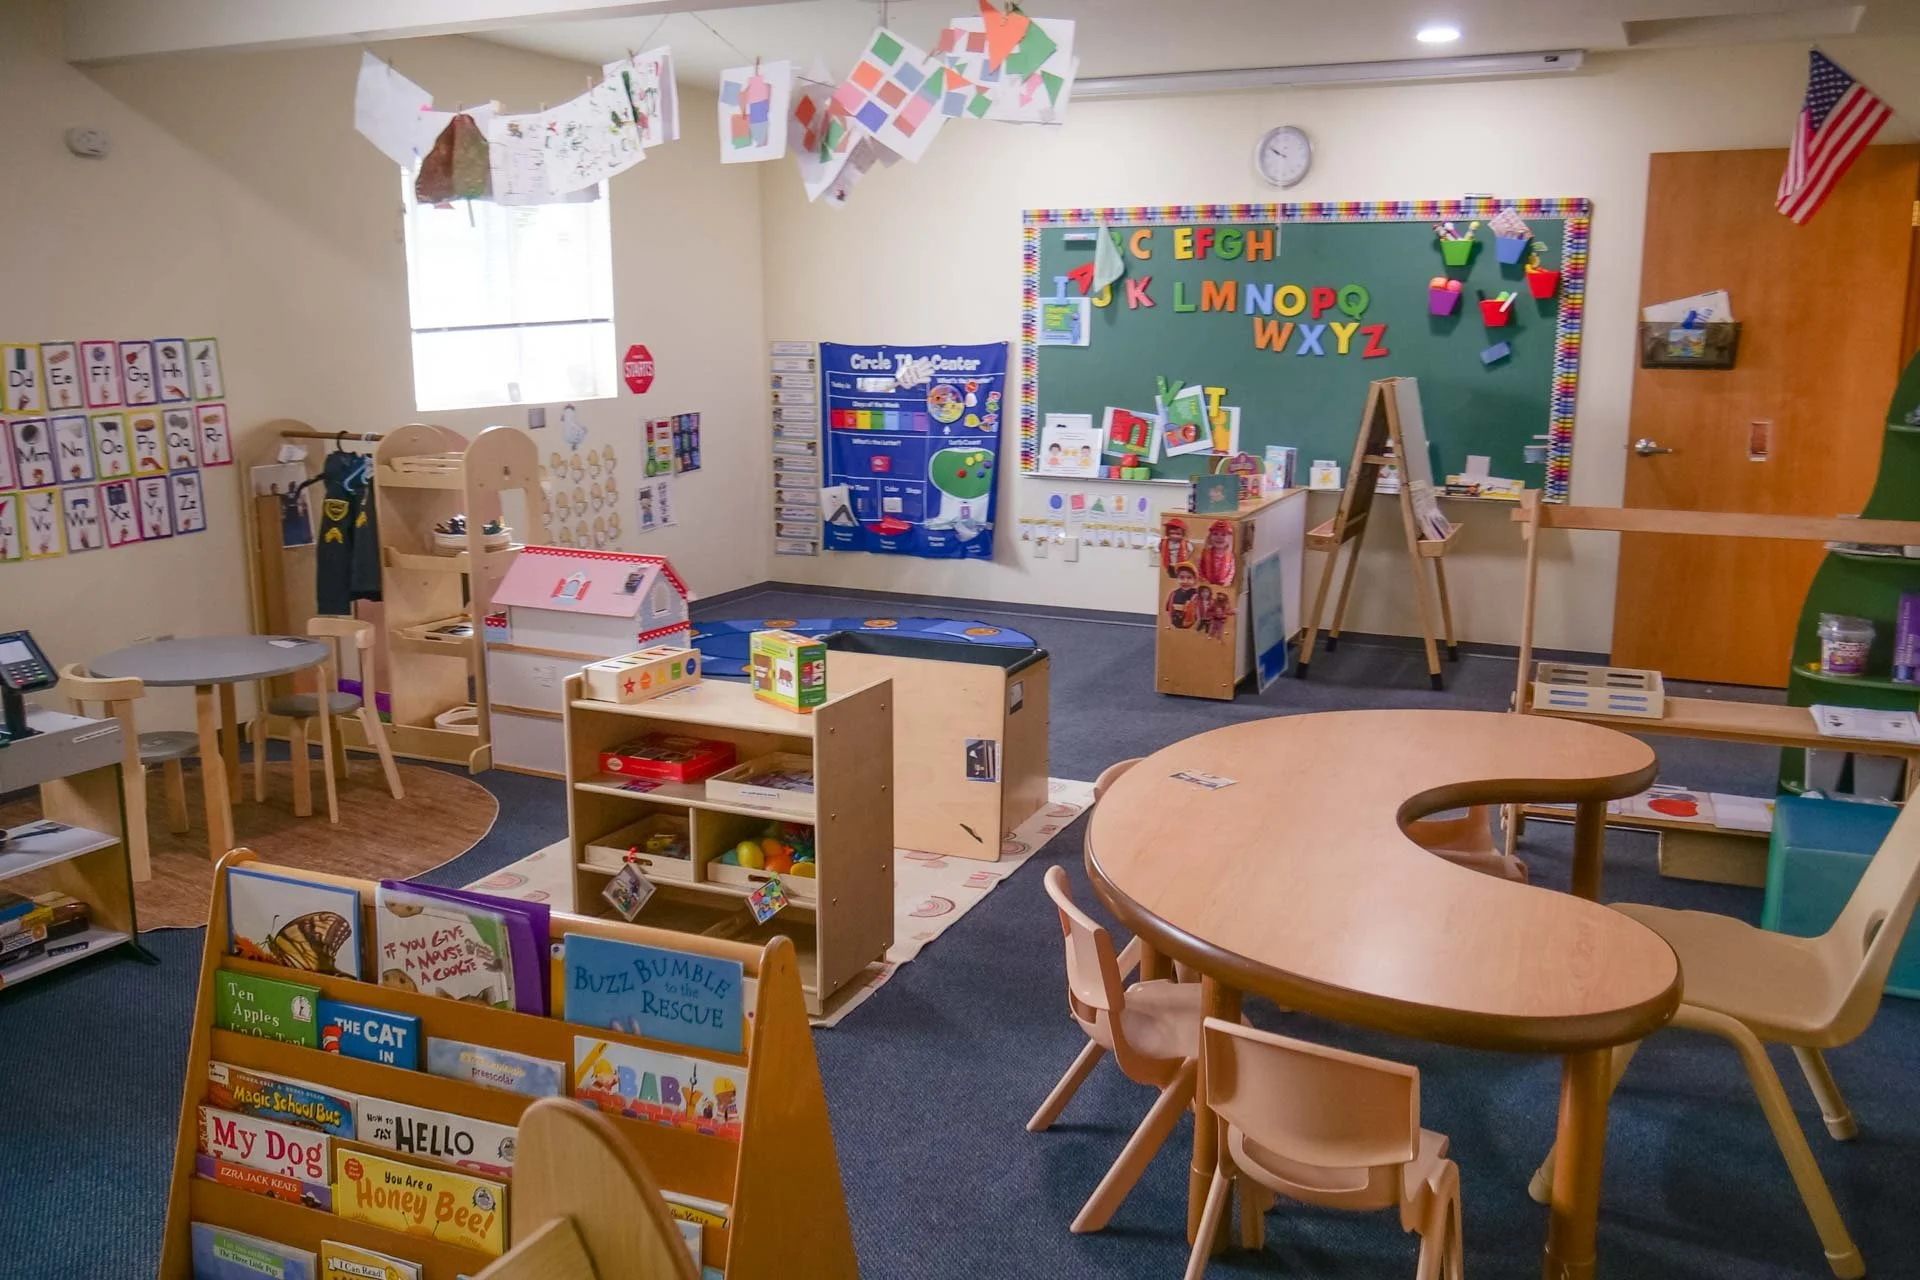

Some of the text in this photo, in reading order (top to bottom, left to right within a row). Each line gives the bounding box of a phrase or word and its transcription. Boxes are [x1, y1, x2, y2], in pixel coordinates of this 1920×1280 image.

[851, 352, 892, 370] Circle
[931, 354, 981, 371] Center
[400, 937, 426, 954] YOU
[405, 944, 463, 971] A MOUSE
[421, 958, 477, 985] A COOKIE
[574, 965, 635, 995] BUZZ
[633, 958, 731, 999] BUMBLE
[228, 982, 254, 1002] Ten
[664, 981, 699, 999] to the
[232, 1002, 280, 1027] Apples
[640, 990, 724, 1029] RESCUE
[334, 1017, 407, 1049] THE CAT
[379, 1049, 394, 1064] IN
[233, 1085, 340, 1126] Magic School Bus
[617, 1066, 703, 1119] BABY
[212, 1116, 256, 1159] My
[265, 1129, 323, 1178] Dog
[374, 1128, 392, 1141] SAY
[396, 1116, 474, 1157] HELLO
[220, 1167, 298, 1192] EZRA JACK KEATS
[385, 1171, 433, 1191] You Are a
[356, 1178, 495, 1239] Honey Bee!
[345, 1263, 360, 1272] Can
